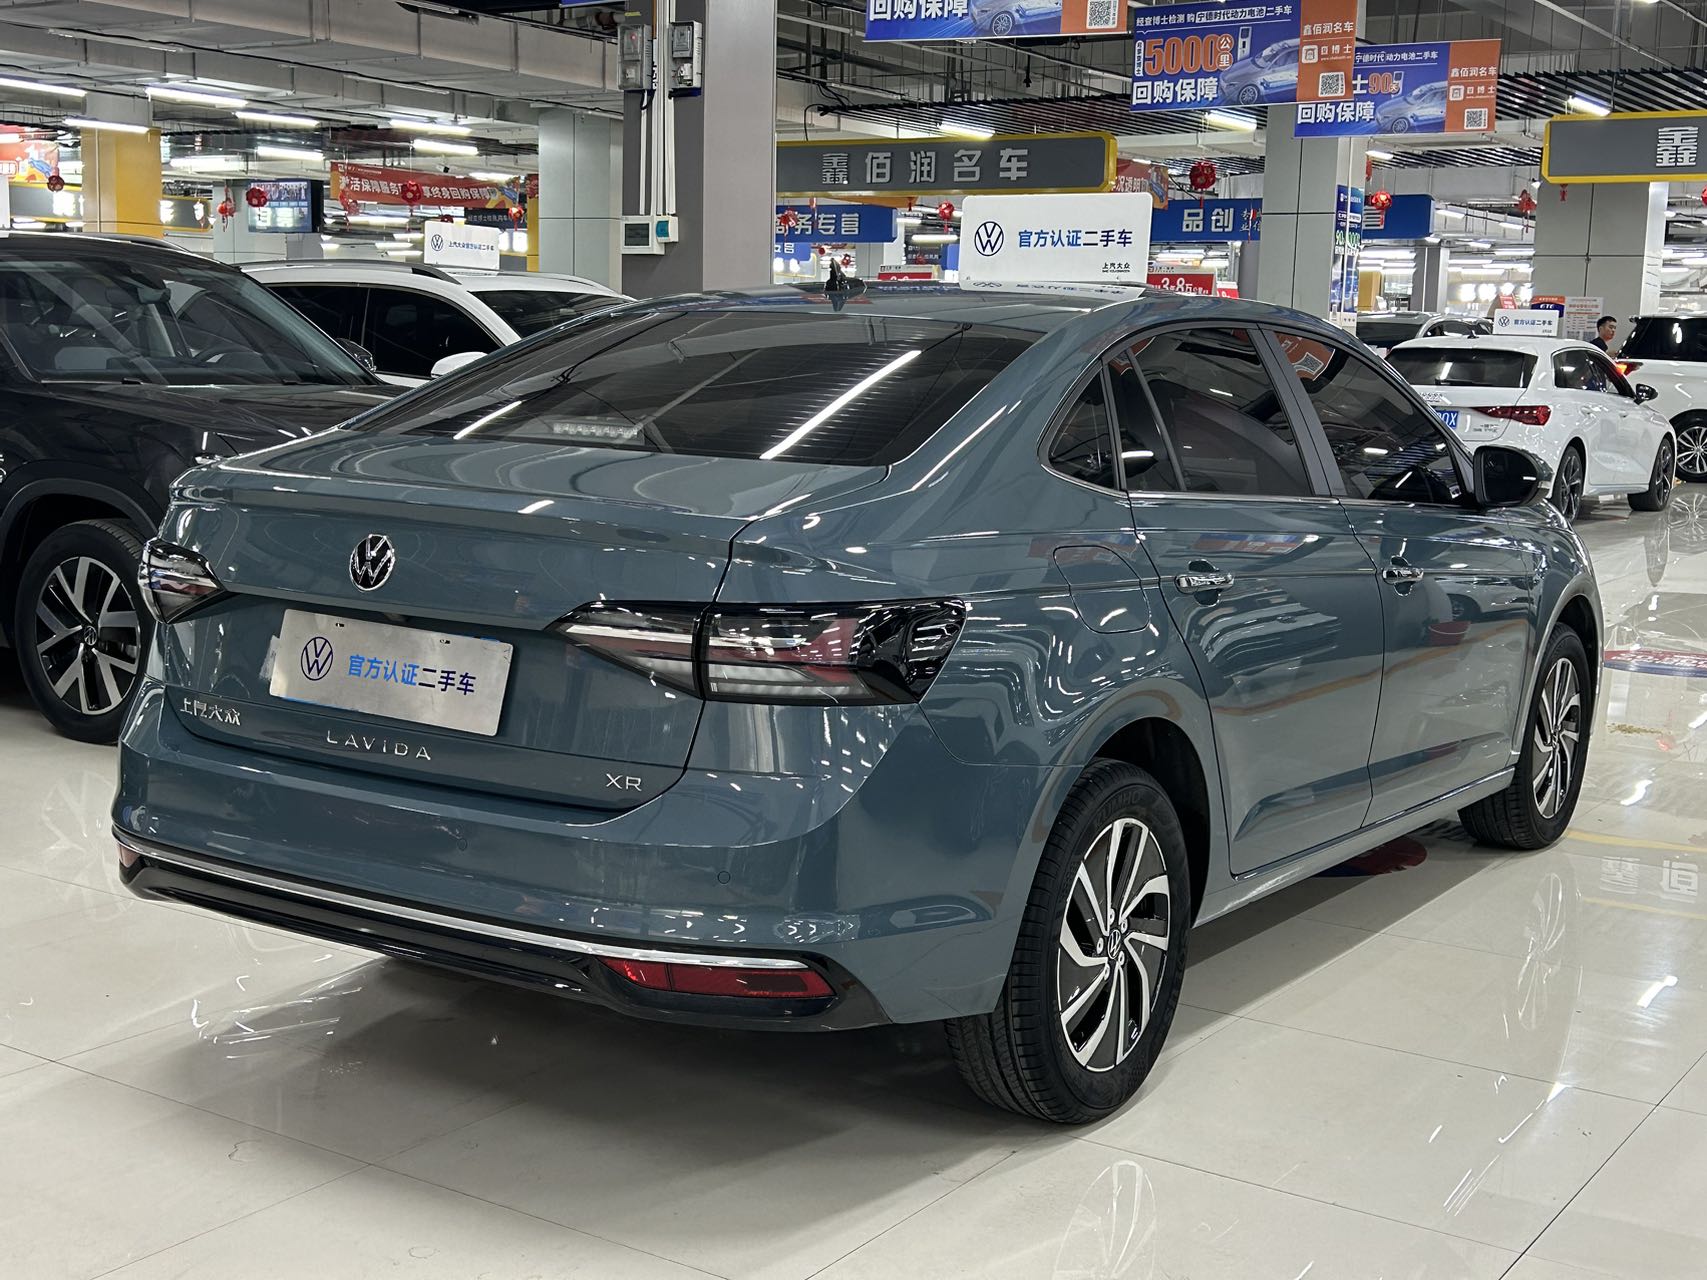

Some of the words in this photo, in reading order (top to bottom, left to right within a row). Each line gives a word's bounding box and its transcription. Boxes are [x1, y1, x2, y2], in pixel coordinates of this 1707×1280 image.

[868, 0, 969, 21] 回购保障
[1303, 21, 1354, 36] 鑫佰润名车
[1132, 77, 1218, 105] 回购保障
[1297, 101, 1376, 124] 回购保障
[1656, 126, 1699, 167] 鑫
[822, 148, 1028, 185] 鑫佰润名车
[1182, 208, 1234, 232] 品创
[1018, 229, 1133, 248] 官方认证二手车
[348, 654, 476, 696] 官方认证二手车
[180, 698, 241, 726] 上汽大众
[606, 773, 643, 791] XR
